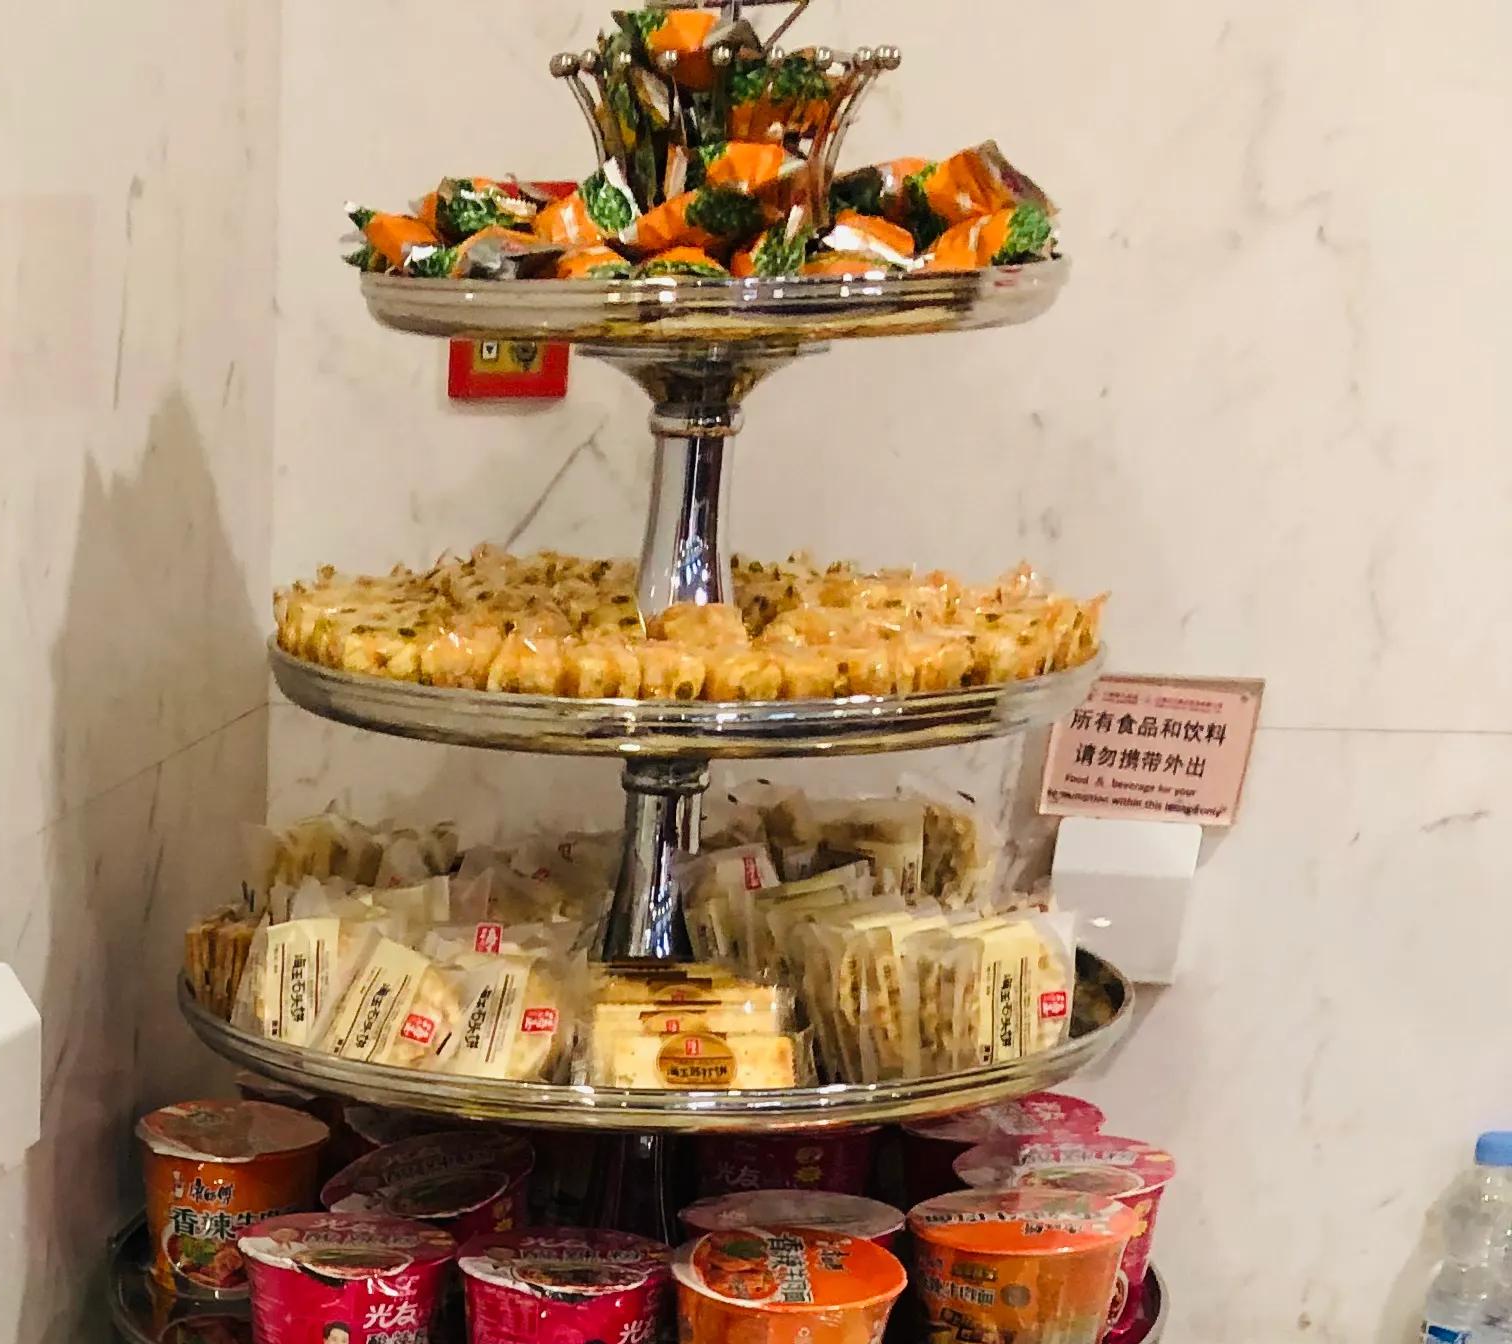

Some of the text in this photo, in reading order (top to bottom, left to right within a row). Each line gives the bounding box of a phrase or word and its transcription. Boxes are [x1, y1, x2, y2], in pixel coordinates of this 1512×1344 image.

[1070, 707, 1228, 747] 所有食品和饮料
[362, 1301, 420, 1330] 光友
